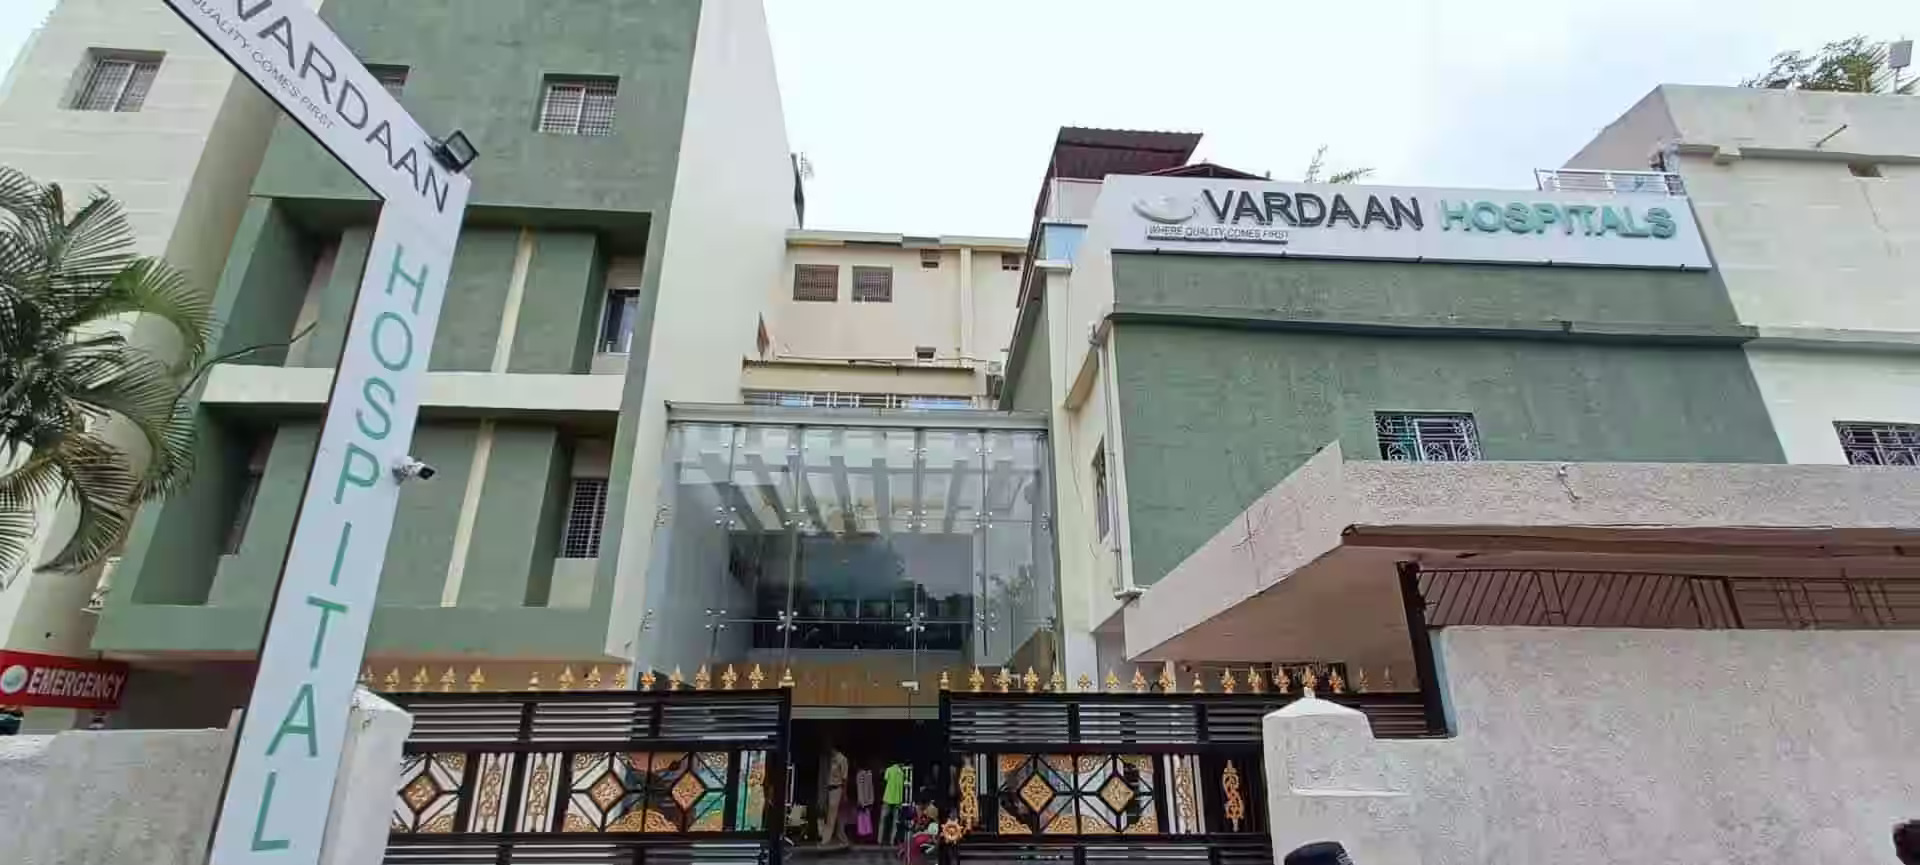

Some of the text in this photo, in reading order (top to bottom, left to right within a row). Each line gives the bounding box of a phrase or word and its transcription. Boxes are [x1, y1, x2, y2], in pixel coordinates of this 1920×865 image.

[252, 50, 300, 97] COMES
[1151, 225, 1288, 240] WHERE QUALITY COMES FIRST
[1203, 189, 1676, 239] VARDAAN HOSPITALS
[251, 244, 428, 852] HOSPITAL
[26, 666, 126, 699] EMERGENCY
